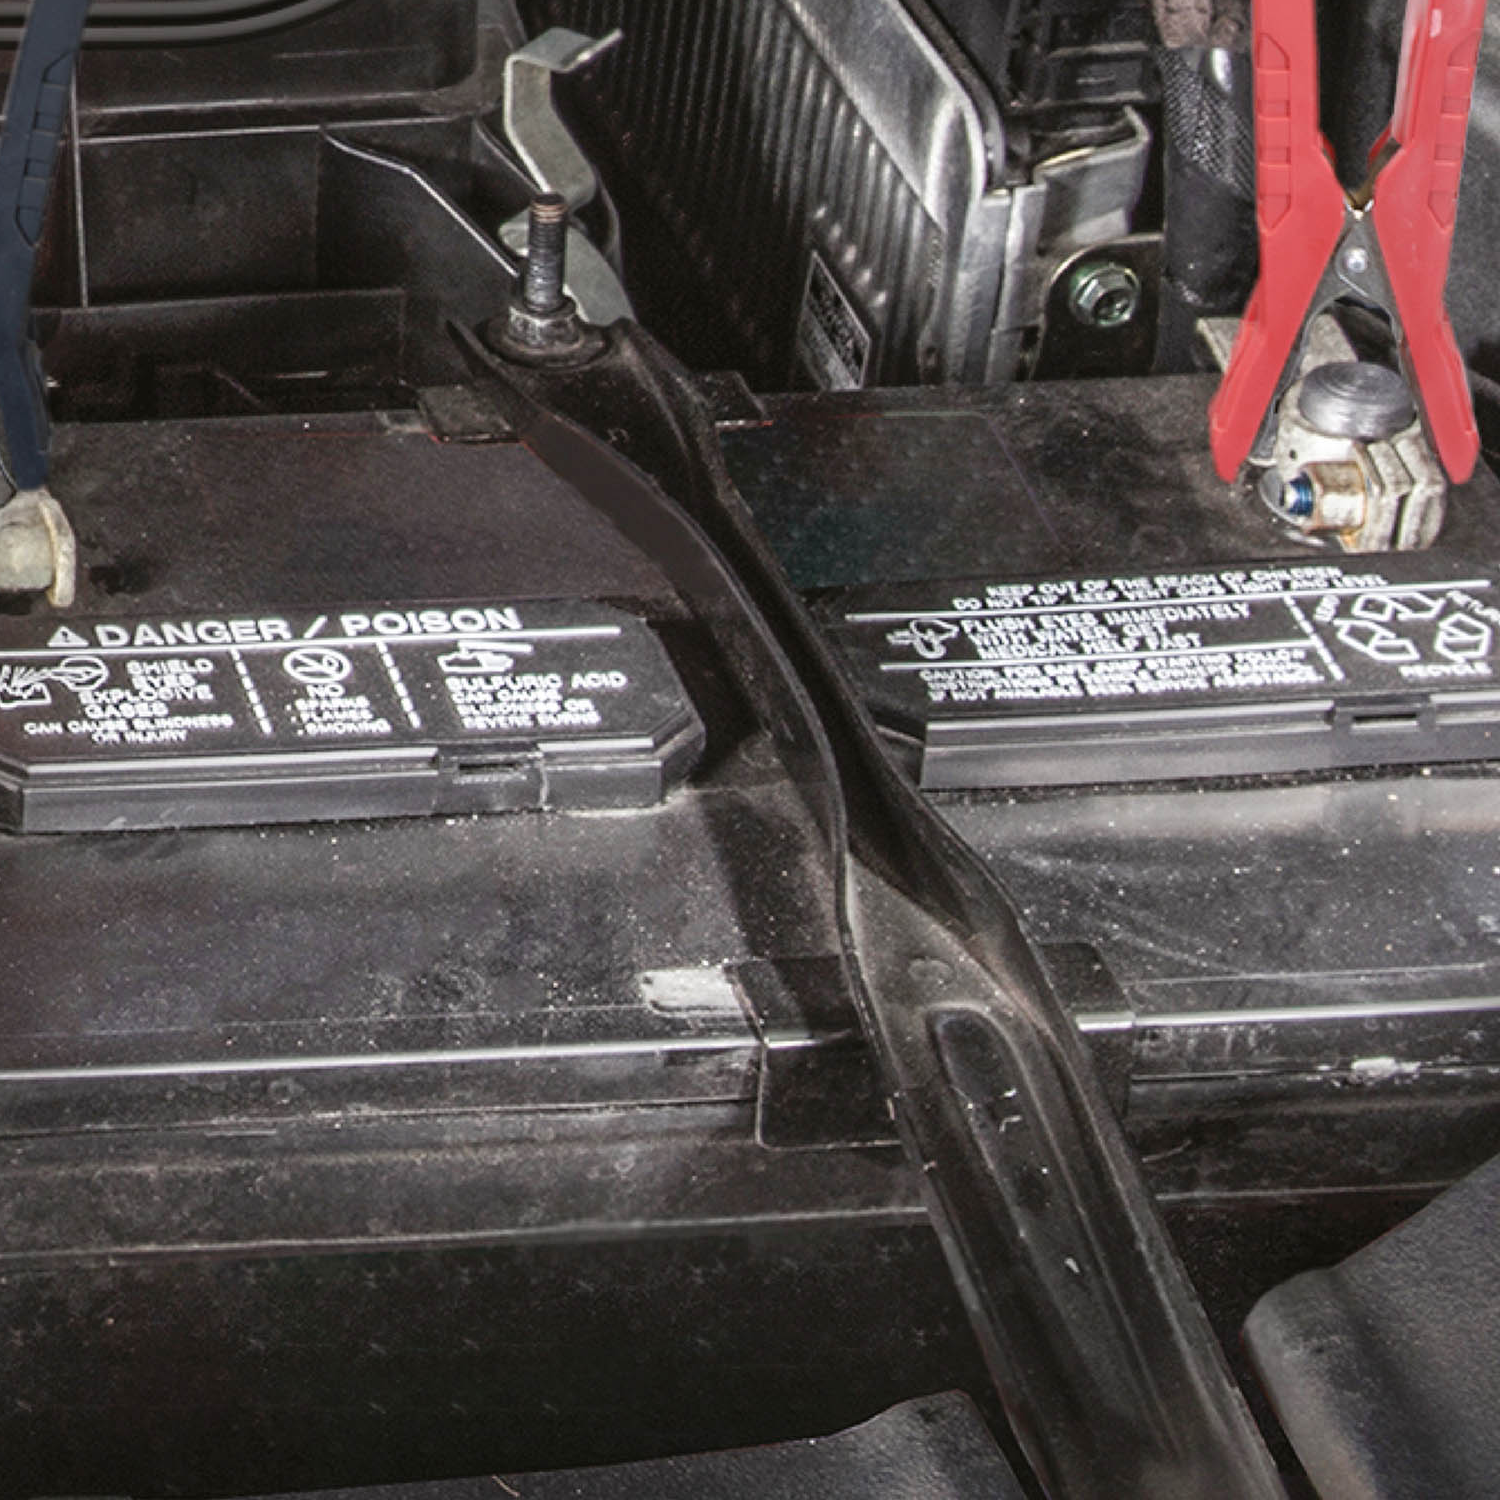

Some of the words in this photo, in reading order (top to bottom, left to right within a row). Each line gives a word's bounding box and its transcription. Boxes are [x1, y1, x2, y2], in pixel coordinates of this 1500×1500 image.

[1037, 581, 1077, 594] OUT
[953, 596, 982, 610] DO
[986, 594, 1025, 608] NOT
[960, 616, 1036, 633] FLUSH
[1039, 612, 1099, 629] EYES
[1103, 603, 1250, 626] IMMEDIATELY
[95, 618, 292, 647] DANGER
[303, 615, 328, 639] /
[340, 607, 522, 636] POISON
[969, 628, 1033, 646] WITH
[975, 640, 1078, 660] MEDICAL
[1079, 636, 1141, 654] HELP
[1145, 633, 1200, 651] FAST
[126, 658, 214, 676] SHIELD
[1399, 662, 1492, 678] RECYCLE
[571, 671, 629, 688] ACID
[78, 684, 214, 705] EXPLOSIVE
[306, 684, 346, 698] NO
[84, 701, 169, 719] GASES
[23, 722, 63, 735] CAN
[67, 718, 130, 733] CAUSE
[305, 718, 393, 735] SMOKING
